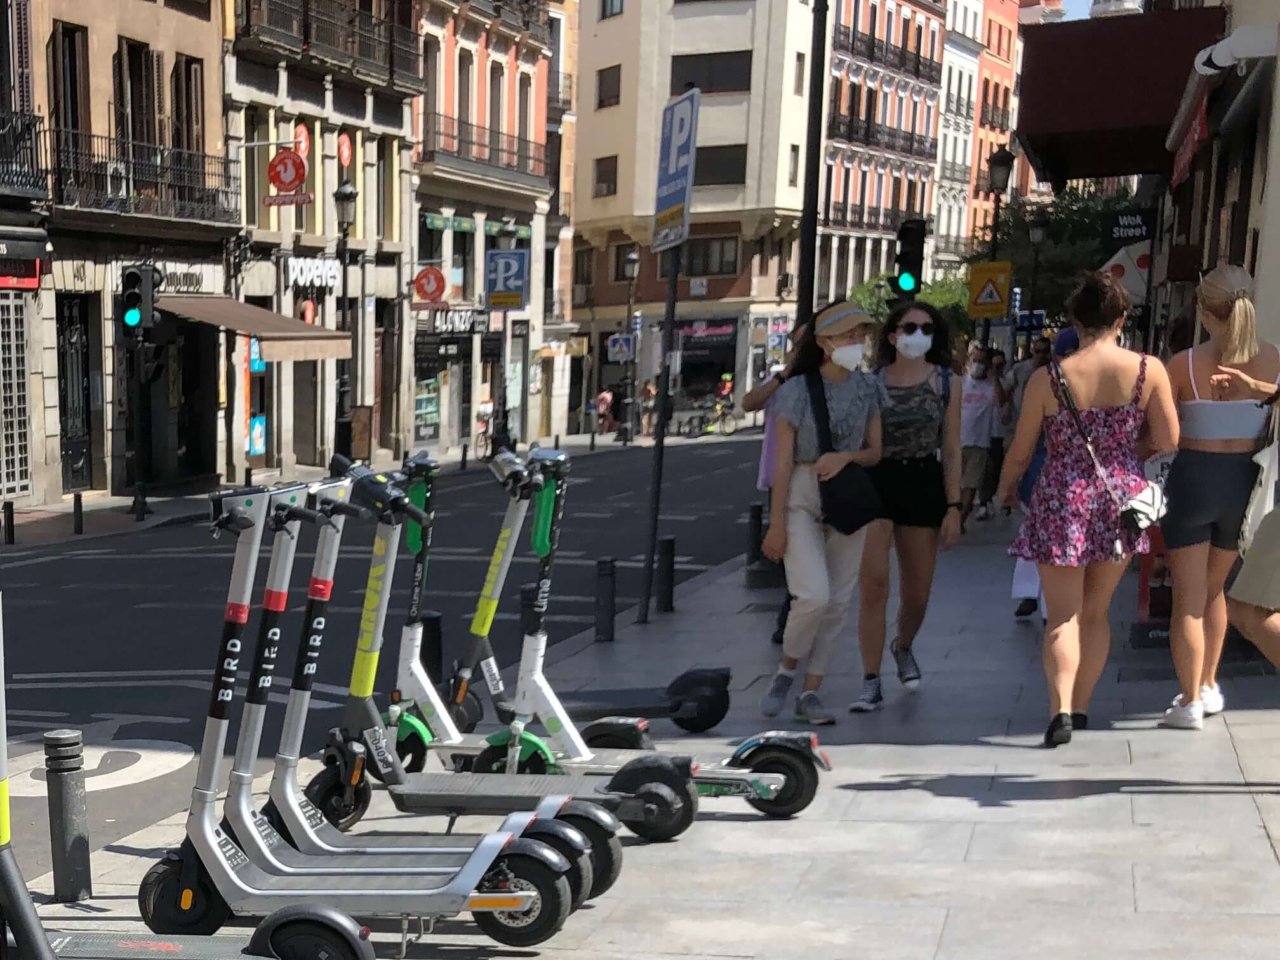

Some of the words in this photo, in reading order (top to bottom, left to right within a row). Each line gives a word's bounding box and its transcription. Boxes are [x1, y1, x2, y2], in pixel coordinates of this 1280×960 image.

[668, 100, 691, 175] P
[1112, 225, 1147, 238] Street
[1119, 214, 1142, 225] Wok
[494, 259, 518, 291] P
[534, 578, 551, 612] Lime
[258, 627, 281, 688] BIRD
[304, 616, 326, 675] BIRD
[218, 638, 241, 701] BIRD
